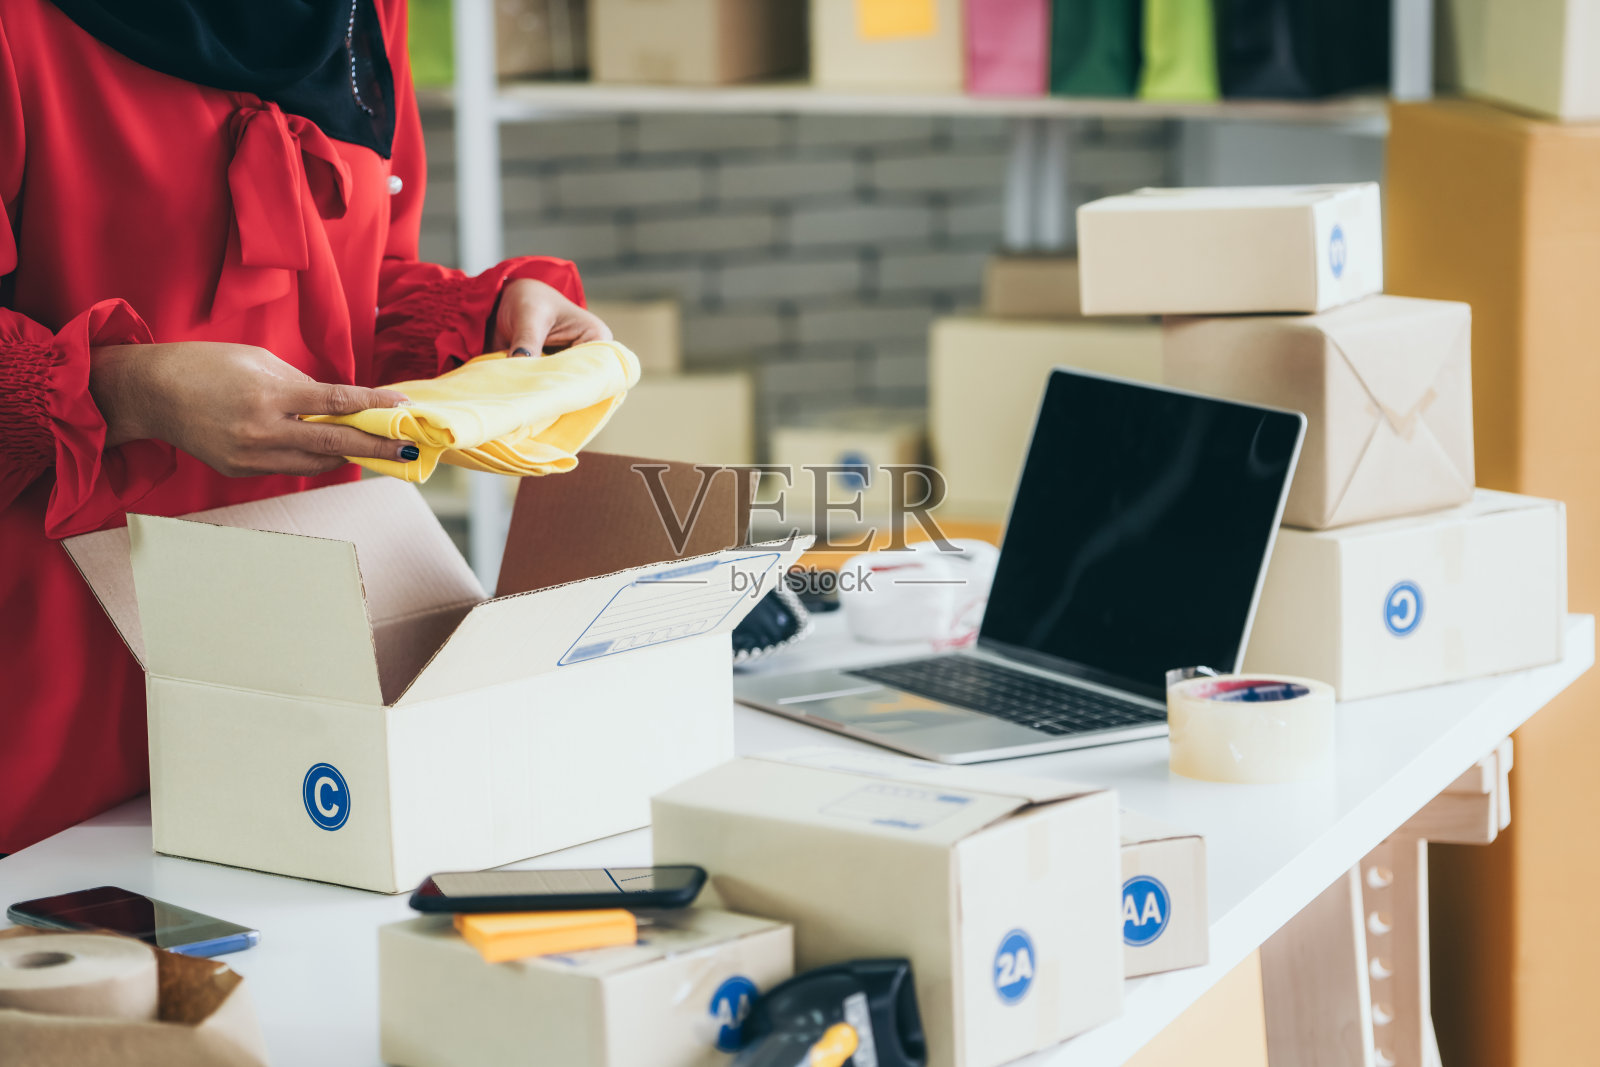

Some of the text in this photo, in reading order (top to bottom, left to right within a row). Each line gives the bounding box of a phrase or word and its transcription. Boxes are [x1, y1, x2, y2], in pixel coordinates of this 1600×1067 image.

[1391, 589, 1417, 629] C
[314, 776, 340, 818] C
[1123, 892, 1162, 926] AA
[998, 947, 1033, 988] 2A
